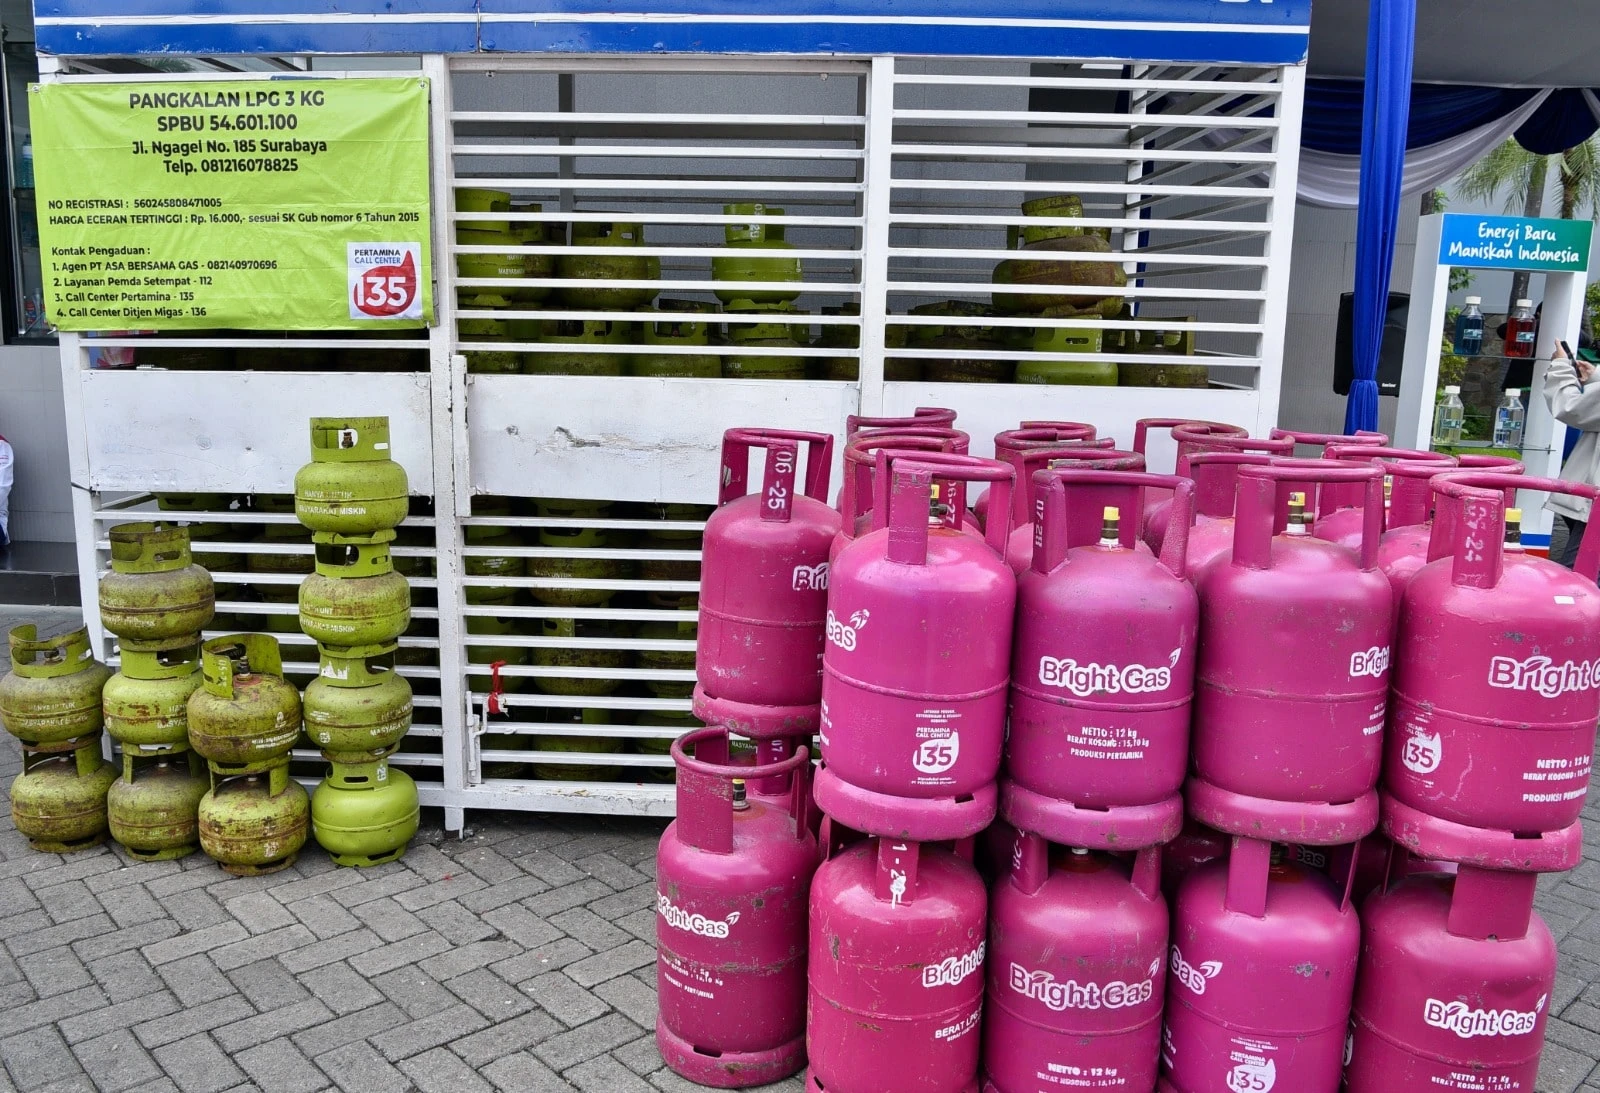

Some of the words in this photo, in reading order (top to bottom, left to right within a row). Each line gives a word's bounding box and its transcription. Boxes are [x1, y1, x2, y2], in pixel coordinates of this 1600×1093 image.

[130, 92, 240, 109] PANGKALAN
[246, 91, 280, 107] LPG
[285, 90, 295, 106] 3
[300, 90, 325, 106] KG
[157, 116, 204, 132] SPBU
[210, 114, 298, 130] 54.601.100
[132, 141, 148, 154] Jl.
[152, 140, 202, 156] Ngagel
[206, 140, 230, 152] No.
[234, 139, 256, 152] 185
[260, 138, 327, 154] Surabaya
[163, 160, 197, 176] Telp.
[201, 158, 298, 173] 081216078825
[48, 200, 62, 210] NO
[66, 199, 123, 209] REGISTRASI
[134, 198, 222, 208] 560245808471005
[50, 216, 84, 225] HARGA
[87, 215, 127, 224] ECERAN
[130, 214, 182, 224] TERTINGGI
[190, 214, 206, 225] Rp.
[248, 212, 280, 223] sesuai
[282, 213, 296, 223] SK
[298, 212, 318, 223] Gub
[321, 214, 353, 222] nomor
[356, 213, 362, 222] 6
[364, 212, 395, 222] Tahun
[398, 212, 419, 222] 2015
[1478, 222, 1520, 247] Energi
[1524, 224, 1556, 241] Baru
[52, 246, 85, 256] Kontak
[89, 246, 145, 257] Pengaduan
[1448, 241, 1513, 260] Maniskan
[1518, 245, 1580, 263] Indonesia
[53, 262, 59, 272] 1.
[62, 262, 87, 273] Agen
[90, 262, 102, 270] PT
[105, 261, 126, 270] ASA
[128, 261, 176, 270] BERSAMA
[178, 260, 198, 270] GAS
[207, 260, 278, 270] 082140970696
[54, 278, 62, 287] 2.
[64, 277, 105, 289] Layanan
[108, 276, 141, 286] Pemda
[144, 276, 191, 288] Setempat
[199, 277, 212, 285] 112
[356, 276, 408, 306] 135
[55, 293, 63, 302] 3.
[66, 292, 84, 302] Call
[87, 293, 119, 302] Center
[121, 291, 171, 301] Pertamina
[180, 292, 194, 300] 135
[57, 309, 66, 318] 4.
[69, 308, 87, 317] Call
[90, 308, 120, 317] Center
[123, 308, 152, 318] Ditjen
[155, 308, 183, 318] Migas
[191, 307, 206, 316] 136
[1488, 655, 1590, 698] Bright
[1067, 735, 1087, 745] BERAT
[1088, 736, 1117, 747] KOSONG
[1082, 726, 1108, 738] NETTO
[1116, 729, 1126, 738] 12
[1127, 728, 1137, 739] kg
[916, 746, 952, 766] 135
[1070, 748, 1105, 759] PRODUKSI
[1107, 751, 1144, 760] PERTAMINA
[1404, 742, 1434, 768] 135
[1537, 759, 1567, 768] NETTO
[1548, 772, 1574, 780] KOSONG
[1523, 793, 1562, 802] PRODUKSI
[690, 914, 729, 938] Gas
[922, 950, 976, 988] Bright
[1170, 944, 1206, 995] Gas
[1010, 962, 1100, 1011] Bright
[1102, 979, 1152, 1008] Gas
[1424, 998, 1499, 1038] Bright
[1500, 1010, 1536, 1036] Gas
[935, 1021, 965, 1038] BERAT
[1048, 1062, 1080, 1076] NETTO
[1230, 1070, 1266, 1090] 135
[1431, 1076, 1454, 1086] BERAT
[1457, 1082, 1484, 1090] KOSONG
